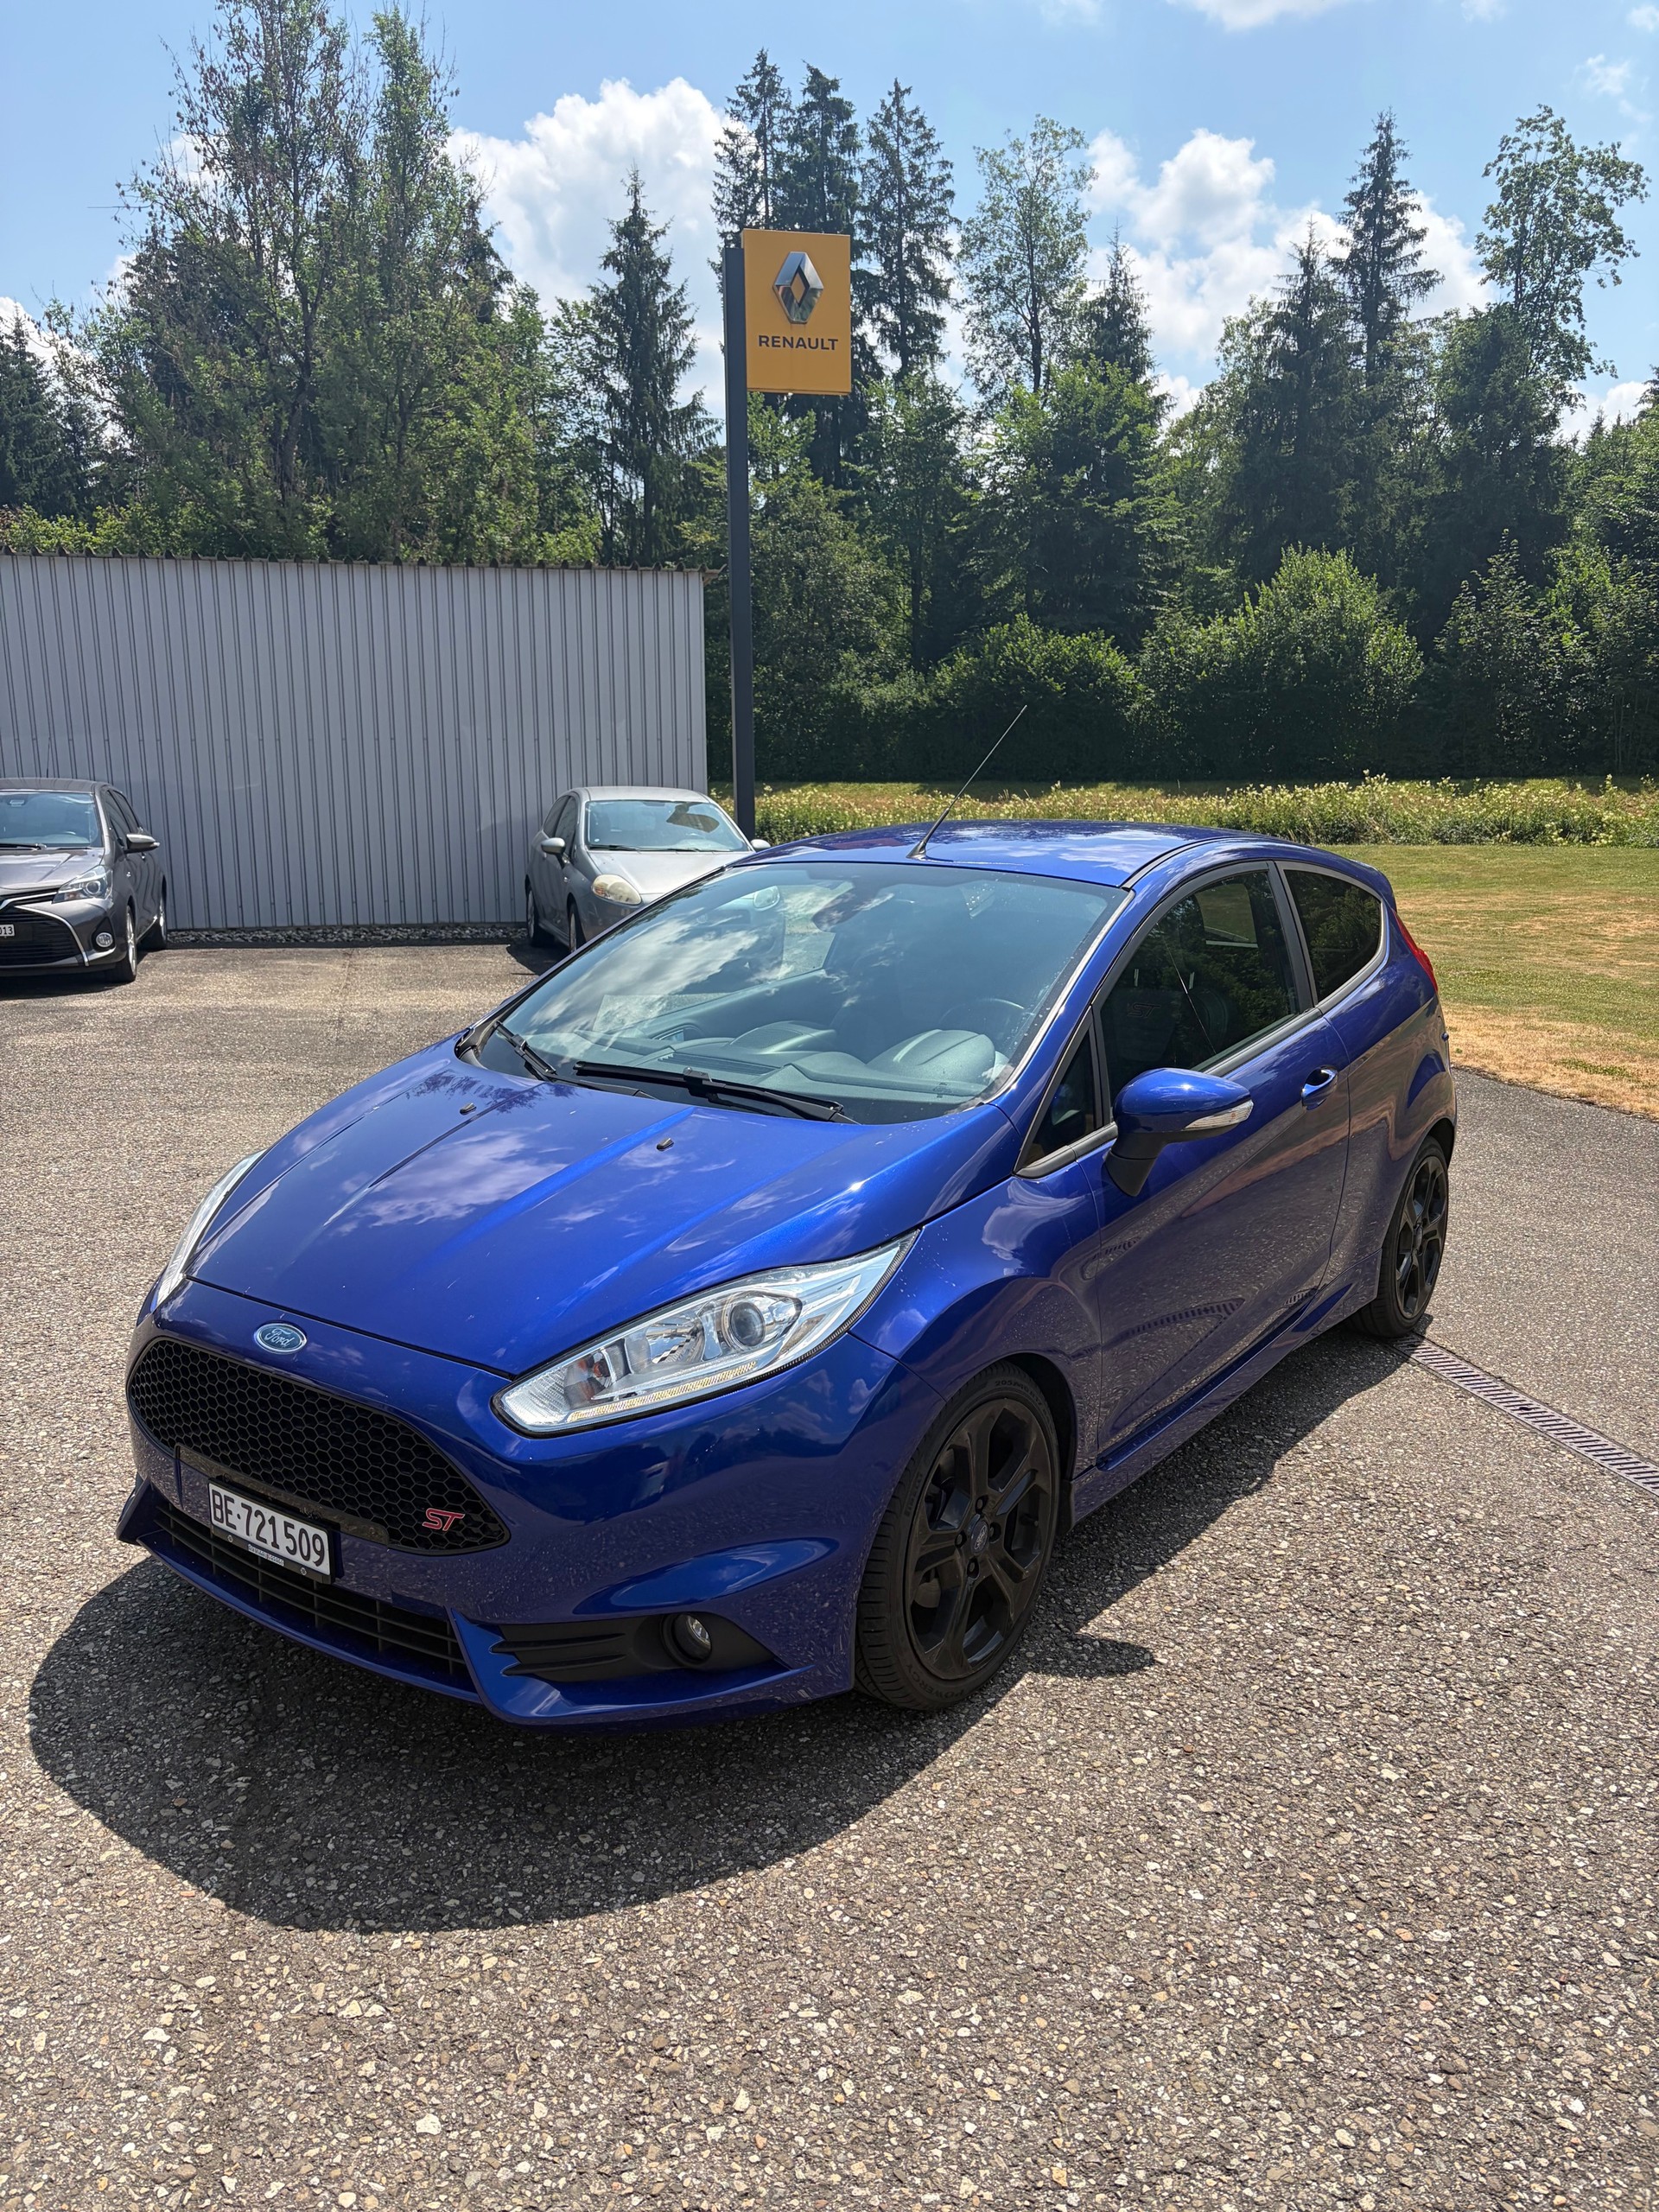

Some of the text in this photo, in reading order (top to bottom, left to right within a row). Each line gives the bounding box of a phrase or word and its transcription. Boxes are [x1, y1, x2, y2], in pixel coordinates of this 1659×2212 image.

[758, 334, 839, 351] RENAULT
[1127, 1001, 1162, 1019] ST
[264, 1327, 296, 1347] Ford
[422, 1508, 466, 1532] ST
